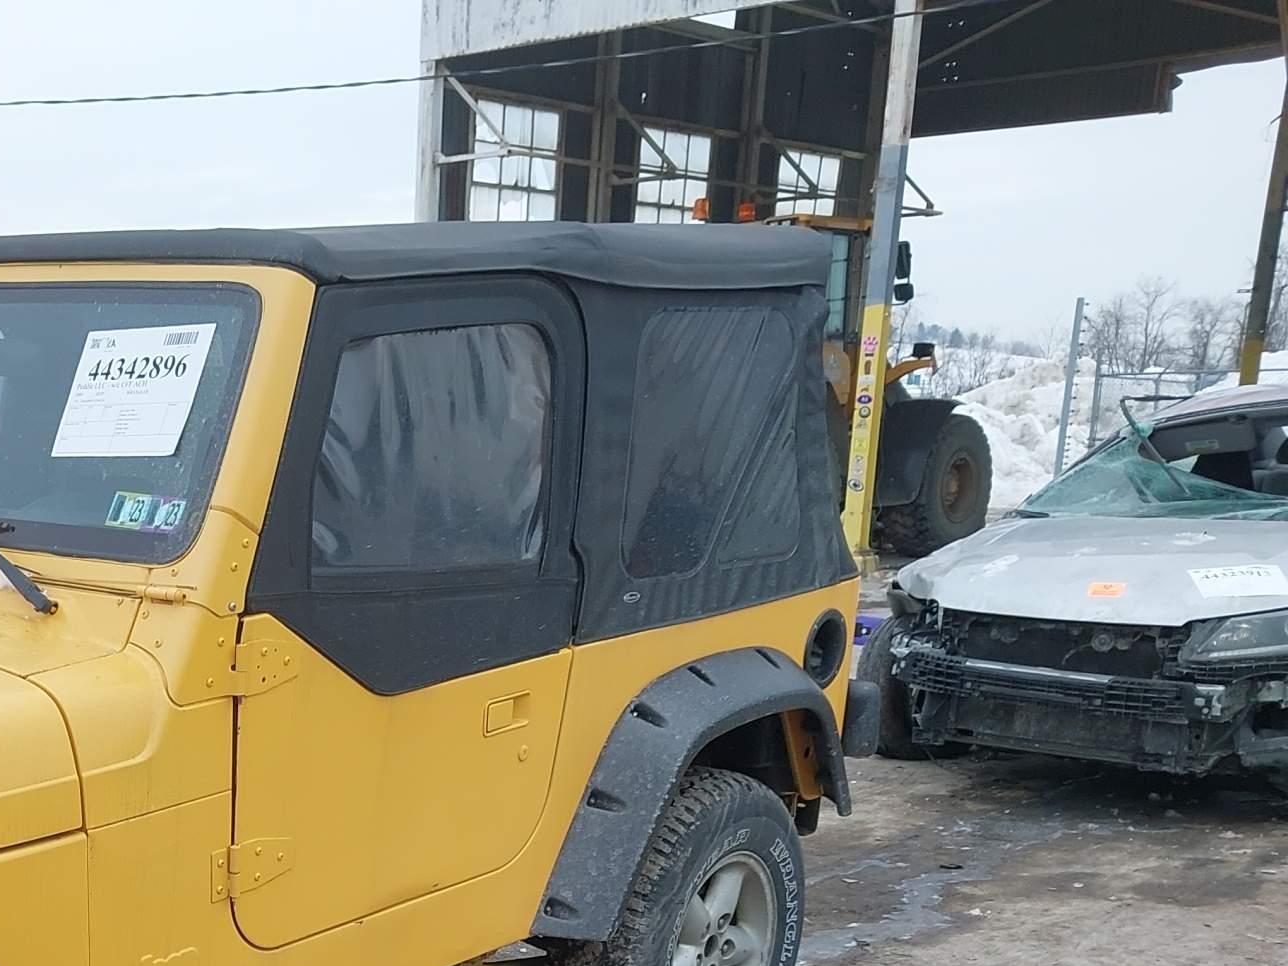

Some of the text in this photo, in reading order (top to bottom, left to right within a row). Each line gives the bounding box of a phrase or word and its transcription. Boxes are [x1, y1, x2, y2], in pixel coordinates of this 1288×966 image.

[88, 353, 192, 382] 44342896
[128, 499, 145, 522] 23
[164, 503, 181, 527] 23
